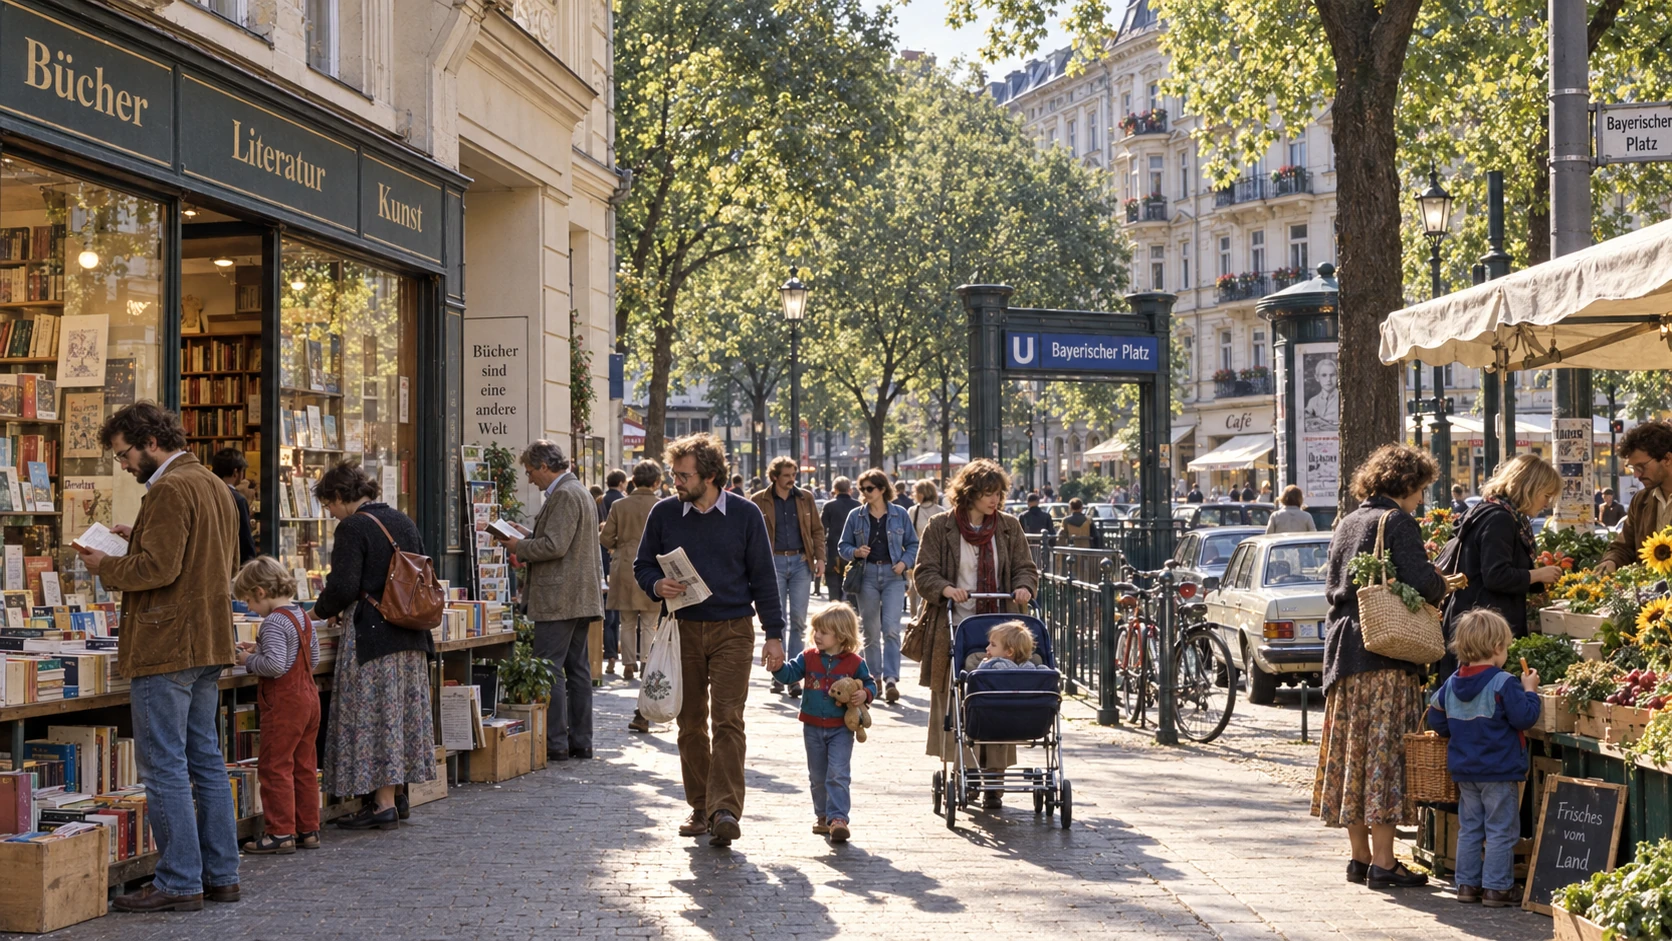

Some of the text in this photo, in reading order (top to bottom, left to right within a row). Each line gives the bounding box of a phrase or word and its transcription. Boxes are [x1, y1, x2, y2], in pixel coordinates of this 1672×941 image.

[24, 36, 149, 127] Bücher
[1607, 113, 1672, 133] Bayerischer
[1626, 136, 1658, 152] Platz
[231, 119, 326, 192] Literatur
[377, 182, 423, 233] Kunst
[473, 344, 519, 358] Bücher
[1013, 336, 1150, 365] U Bayerischer Platz
[481, 364, 507, 377] sind
[480, 384, 506, 397] eine
[476, 402, 517, 416] andere
[478, 421, 508, 435] Welt
[1225, 412, 1252, 432] Café
[1557, 801, 1603, 825] Frisches
[1563, 829, 1586, 842] vom
[1555, 845, 1591, 872] Land
